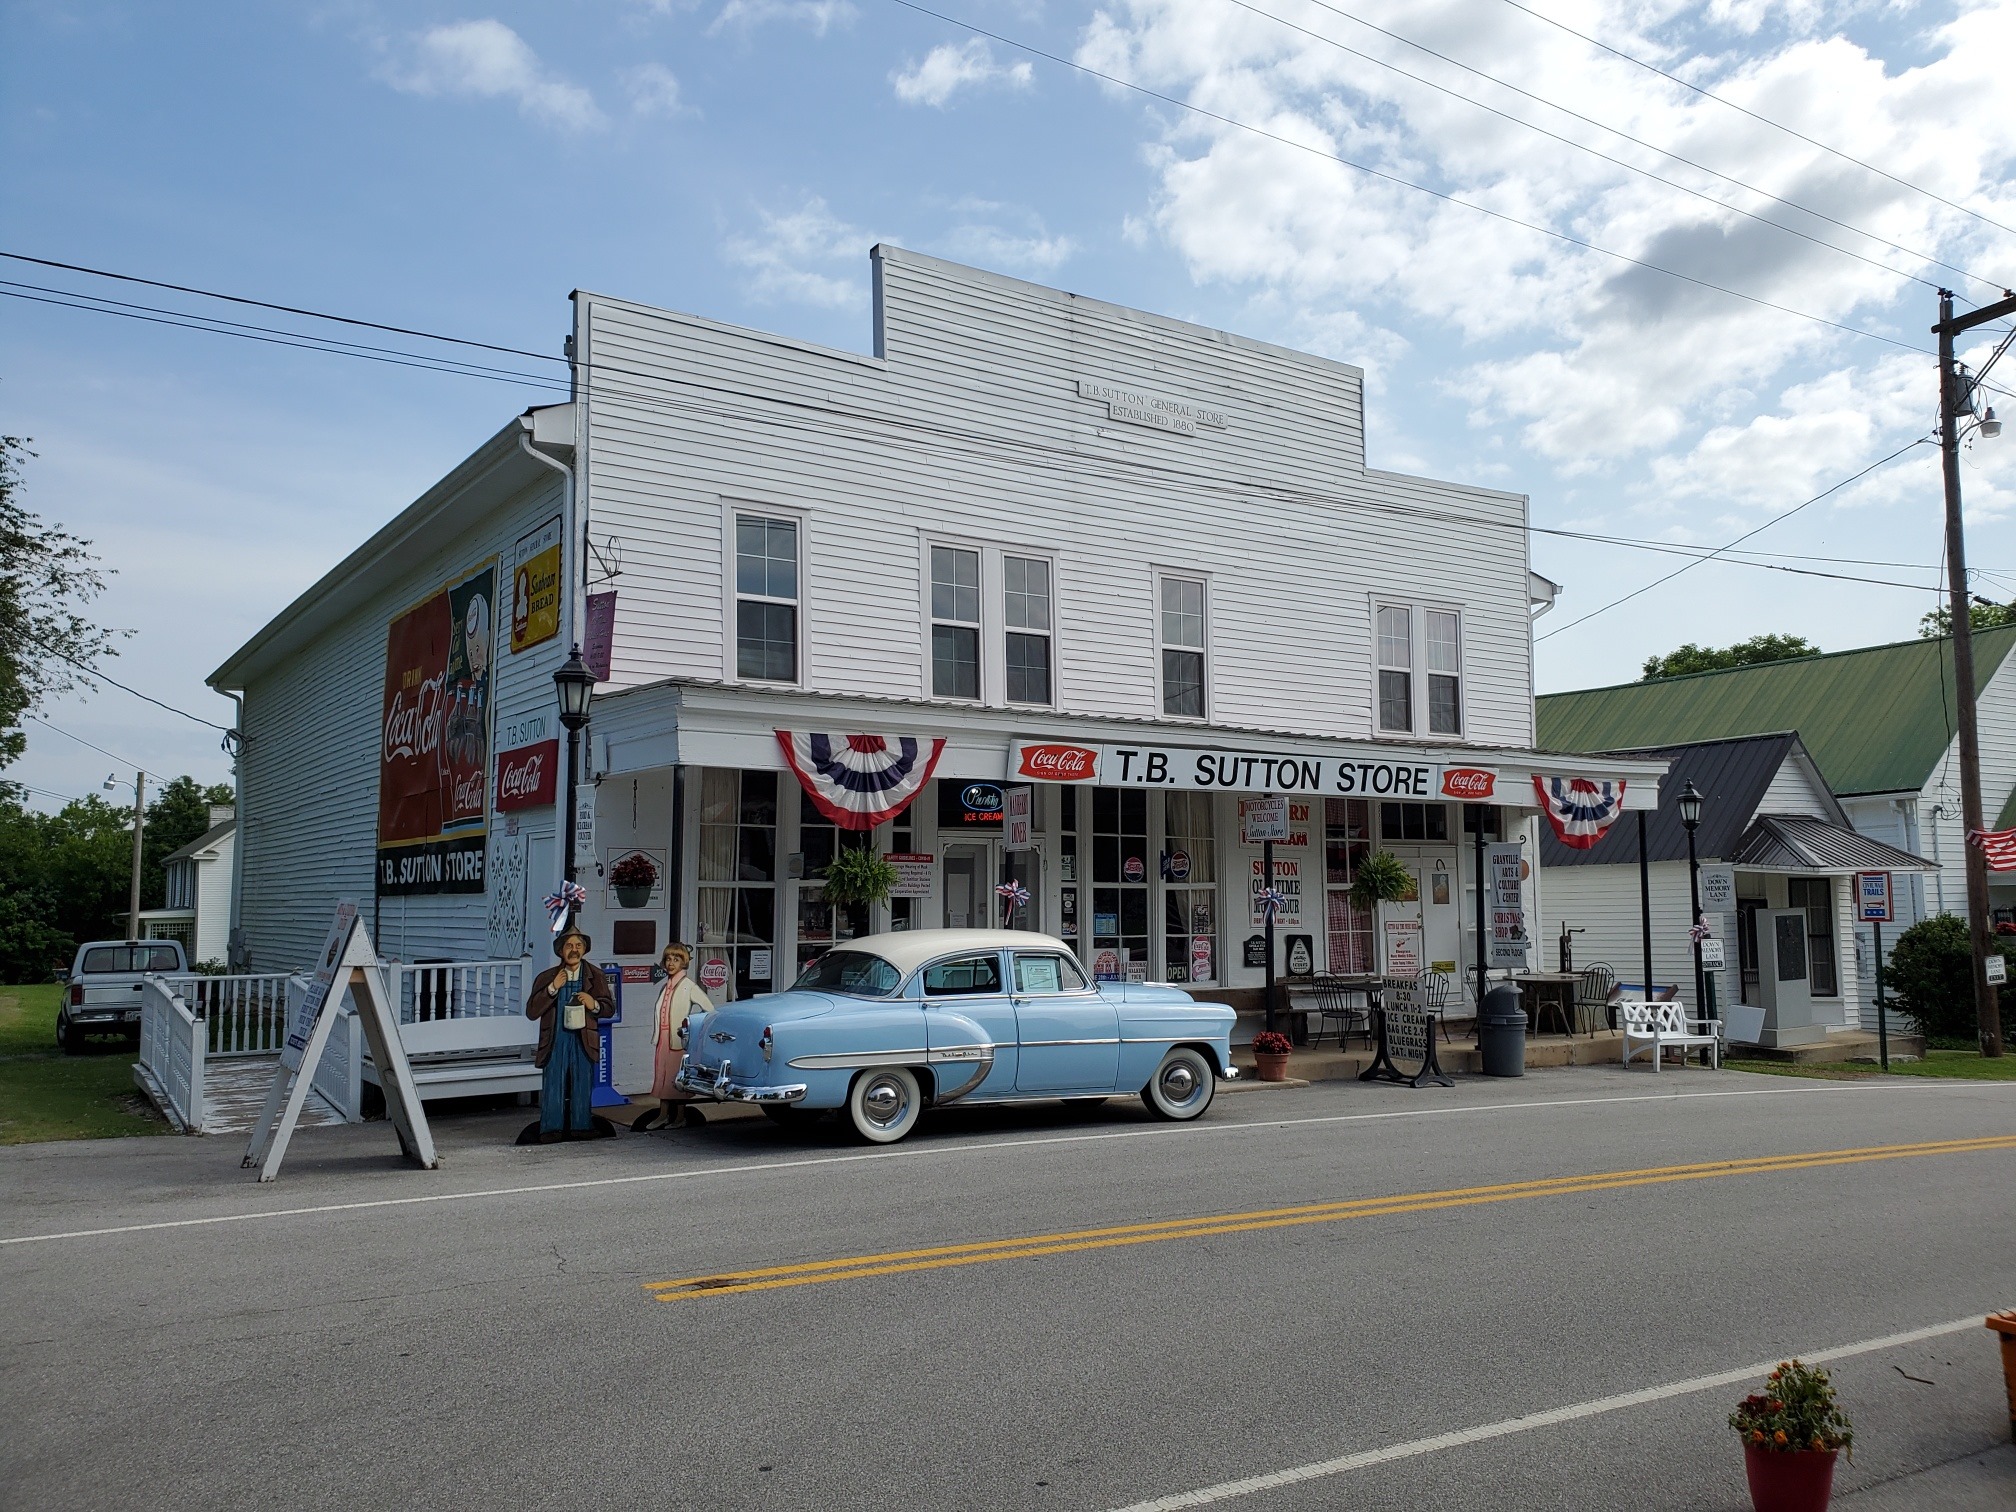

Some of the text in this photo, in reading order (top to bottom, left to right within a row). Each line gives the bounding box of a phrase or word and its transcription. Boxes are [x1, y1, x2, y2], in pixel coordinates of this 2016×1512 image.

[1102, 387, 1145, 406] SUTTON
[1151, 398, 1192, 417] GENERAL
[1196, 409, 1224, 425] STORE
[1113, 405, 1194, 433] ESTABLISHED 1880
[530, 572, 556, 597] Sunbeam
[531, 593, 554, 614] BREAD
[507, 716, 546, 746] T.B. SUTTON
[1116, 750, 1430, 796] T.B. SUTTON STORE
[1245, 800, 1284, 812] MOTORCYCLES
[964, 812, 1004, 821] ICE CREAM
[1252, 812, 1279, 823] WELCOME
[1011, 822, 1027, 843] DINER
[1268, 823, 1284, 837] Store
[1493, 854, 1519, 865] GRANVILLE
[400, 854, 442, 884] SUTTON
[446, 850, 482, 881] STORE
[1253, 861, 1298, 876] SUTON
[1502, 867, 1514, 877] ARTS
[1275, 880, 1300, 895] TIME
[1498, 880, 1519, 890] CULTURE
[1503, 892, 1519, 903] CENTER
[1494, 912, 1520, 924] CHRISTMAS
[1495, 927, 1508, 938] SHOP
[1496, 949, 1511, 957] SECOND
[1167, 966, 1187, 980] OPEN
[1383, 979, 1418, 991] BREAKFAS
[1396, 991, 1411, 1001] 8:30
[1386, 1002, 1408, 1013] LUNCH
[1388, 1013, 1427, 1025] ICE CREAM
[1387, 1024, 1399, 1034] BAG
[1401, 1025, 1412, 1035] ICE
[1389, 1035, 1427, 1049] BLUEGRASS
[1391, 1047, 1407, 1057] SAT.
